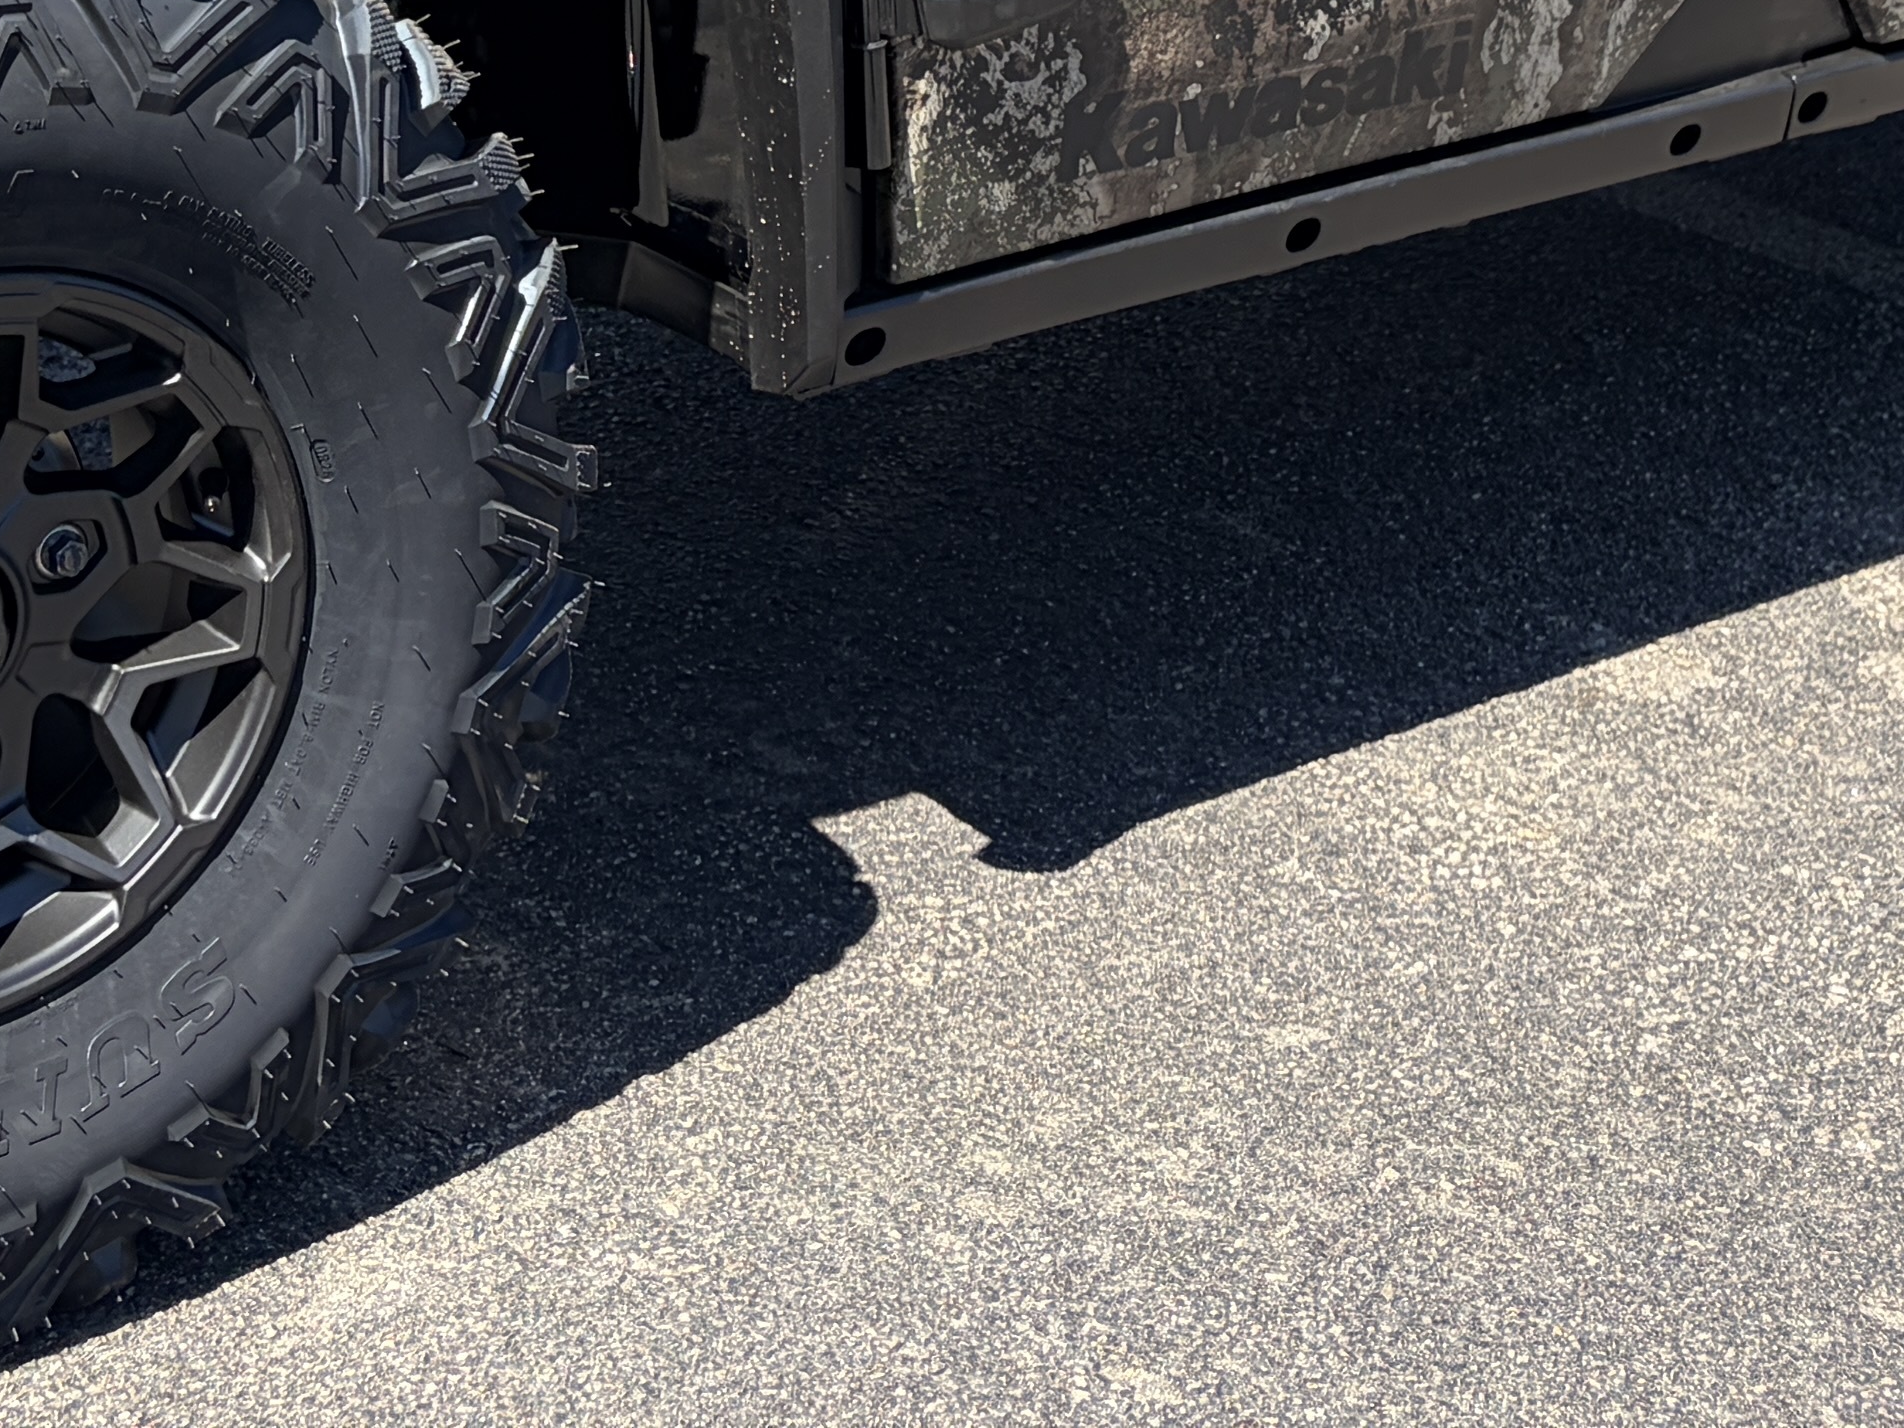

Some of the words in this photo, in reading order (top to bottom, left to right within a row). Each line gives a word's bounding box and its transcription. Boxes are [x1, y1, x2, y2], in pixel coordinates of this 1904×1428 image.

[1058, 18, 1473, 184] Kawasaki
[367, 699, 386, 731] NOT
[352, 738, 374, 766] FOR
[323, 773, 361, 835] HIGHWAY
